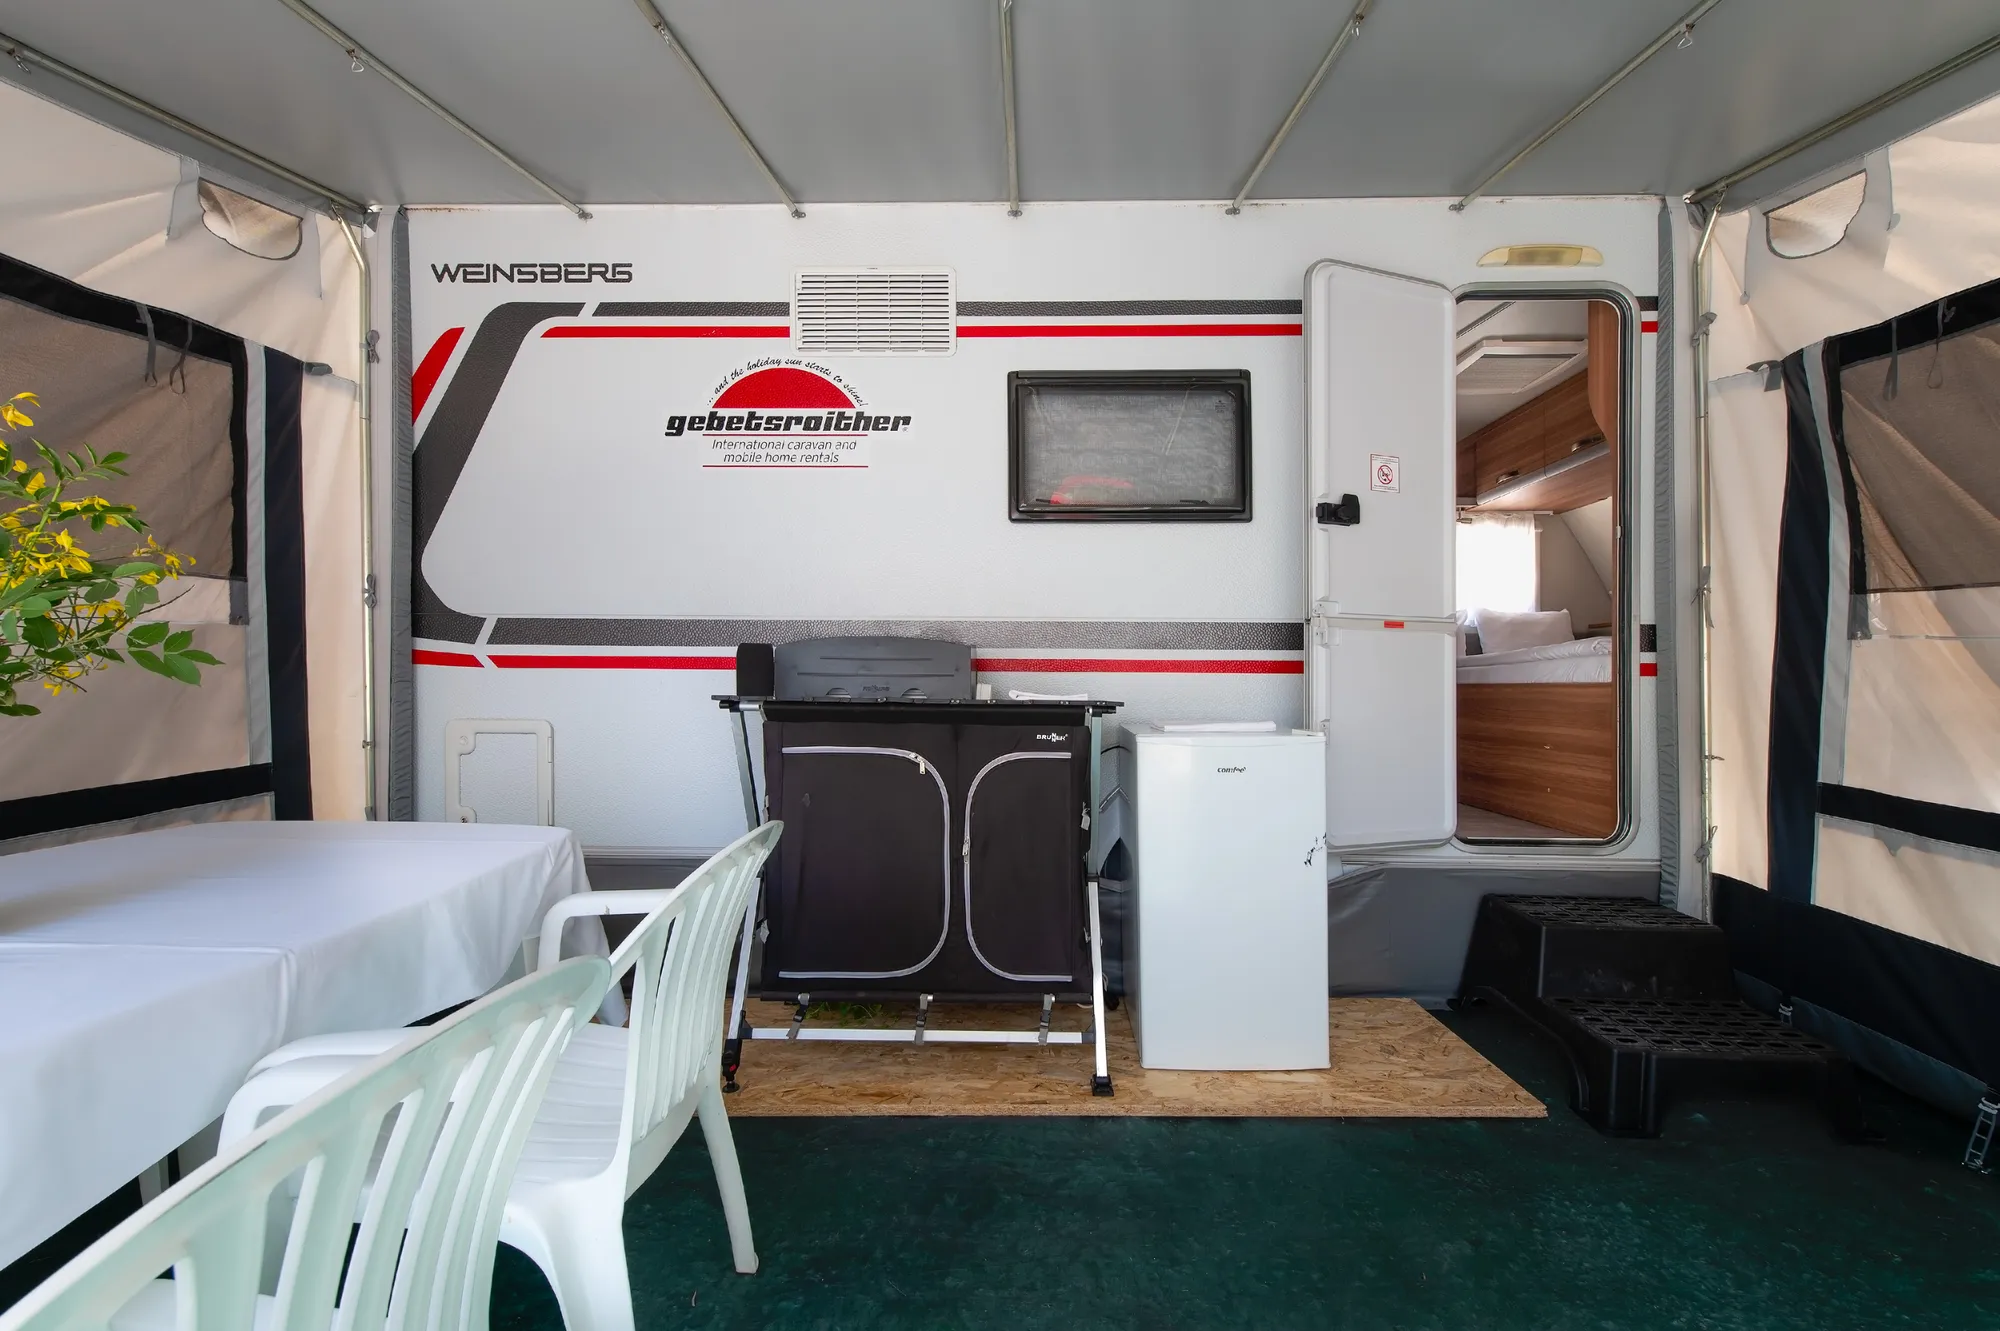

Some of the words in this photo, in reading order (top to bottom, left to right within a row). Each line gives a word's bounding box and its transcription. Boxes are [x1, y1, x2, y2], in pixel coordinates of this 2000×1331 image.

[430, 263, 633, 283] WEINSBERG
[730, 368, 745, 381] the
[746, 357, 782, 371] holiday
[784, 358, 803, 366] sun
[804, 361, 832, 377] starts
[833, 375, 843, 383] to
[664, 411, 912, 437] gebetsroither
[711, 439, 785, 450] International
[787, 440, 832, 450] caravan
[835, 440, 857, 450] and
[723, 452, 762, 463] mobile
[765, 452, 797, 463] home
[799, 452, 839, 463] rentals
